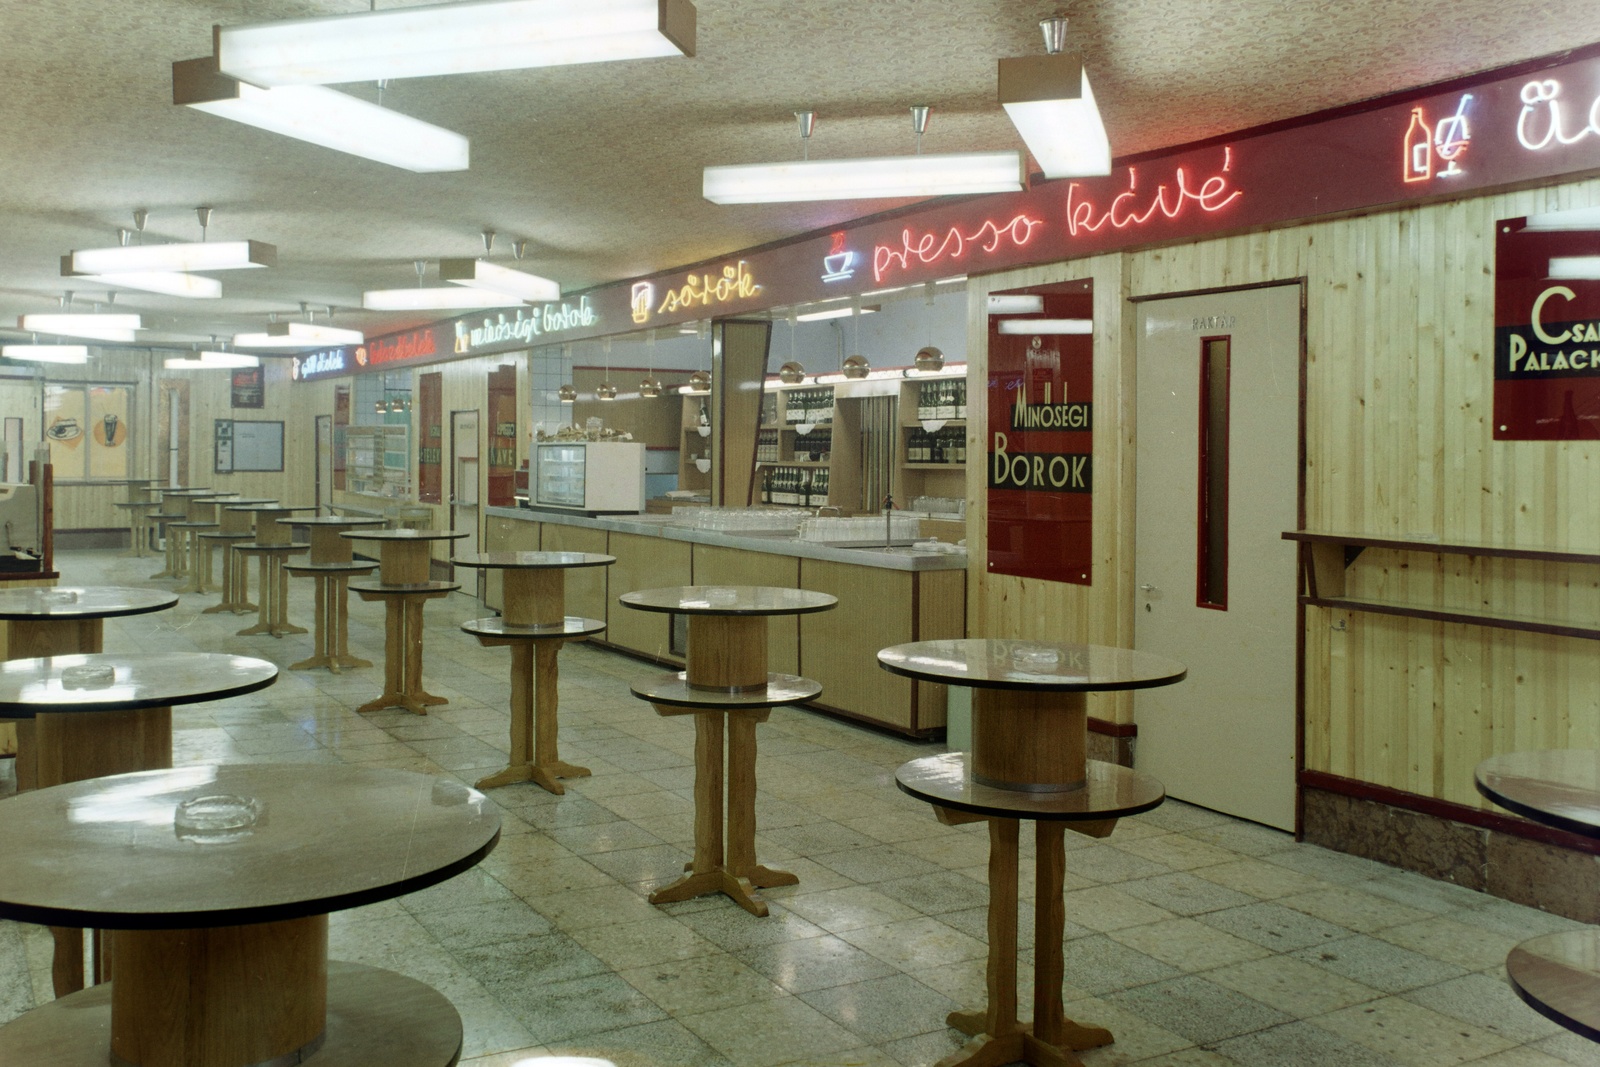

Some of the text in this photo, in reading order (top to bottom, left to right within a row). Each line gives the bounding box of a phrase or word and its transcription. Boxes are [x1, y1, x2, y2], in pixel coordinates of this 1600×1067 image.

[873, 146, 1243, 282] presso kávé
[657, 260, 762, 313] sörök
[543, 295, 595, 332] borok
[1192, 310, 1236, 330] RAKTÁR
[1531, 285, 1600, 345] CSA
[1013, 381, 1088, 428] MINŐSÉGI
[994, 431, 1087, 488] BOROK
